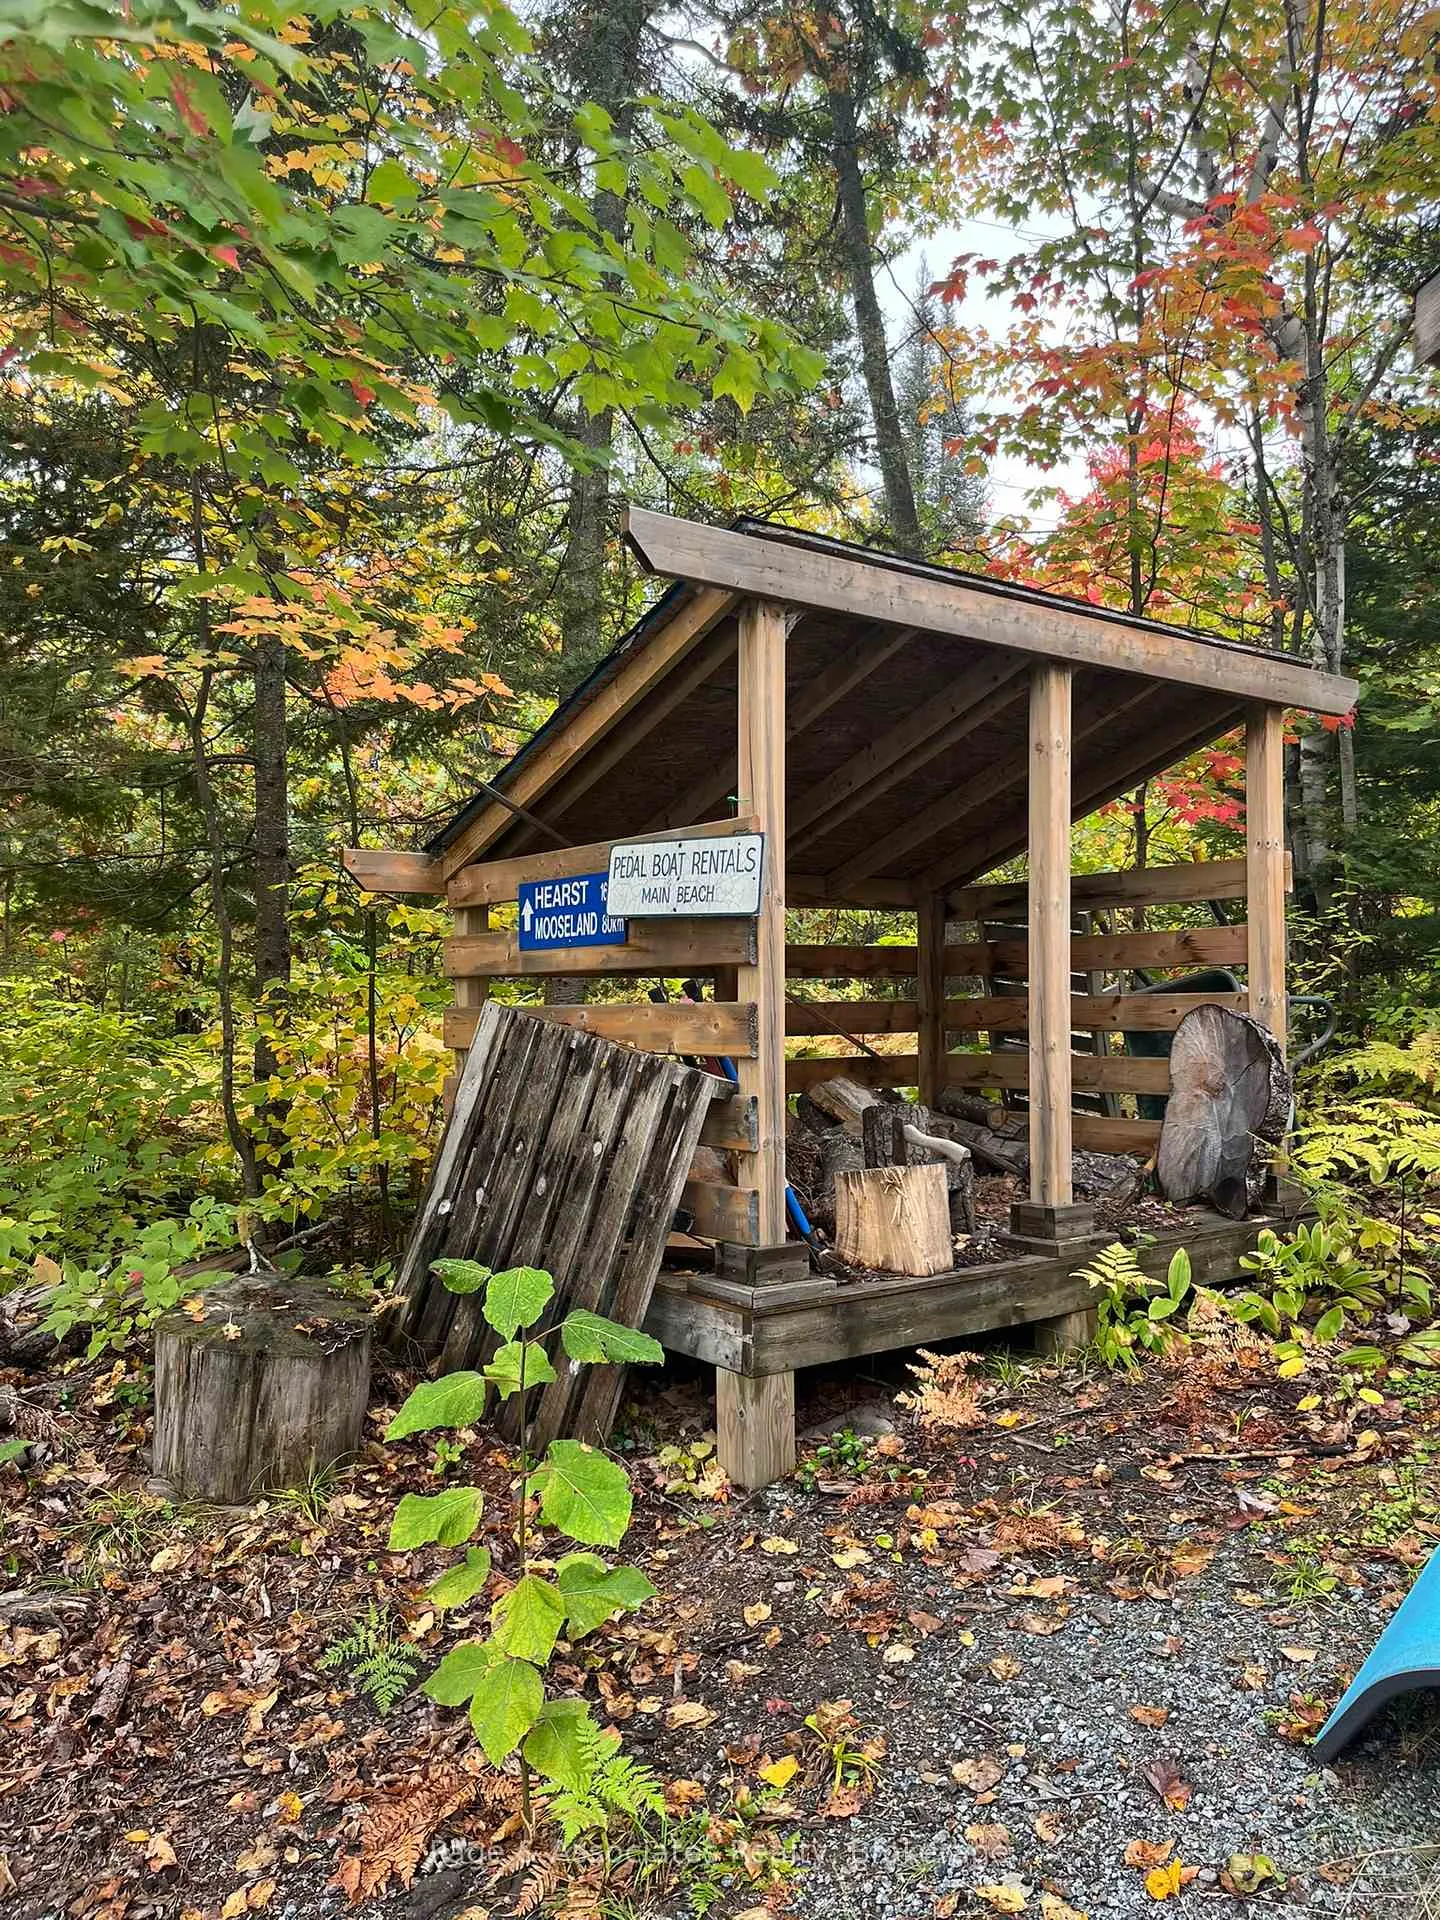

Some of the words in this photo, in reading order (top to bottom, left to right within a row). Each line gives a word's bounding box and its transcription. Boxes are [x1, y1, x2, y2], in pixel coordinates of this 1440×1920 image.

[613, 854, 647, 879] PEDAL
[652, 852, 686, 877] BOAT
[692, 847, 757, 874] RENTALS
[535, 880, 589, 909] HEARST
[641, 887, 670, 904] MAIN
[677, 885, 715, 903] BEACH
[535, 913, 598, 940] MOOSELAND
